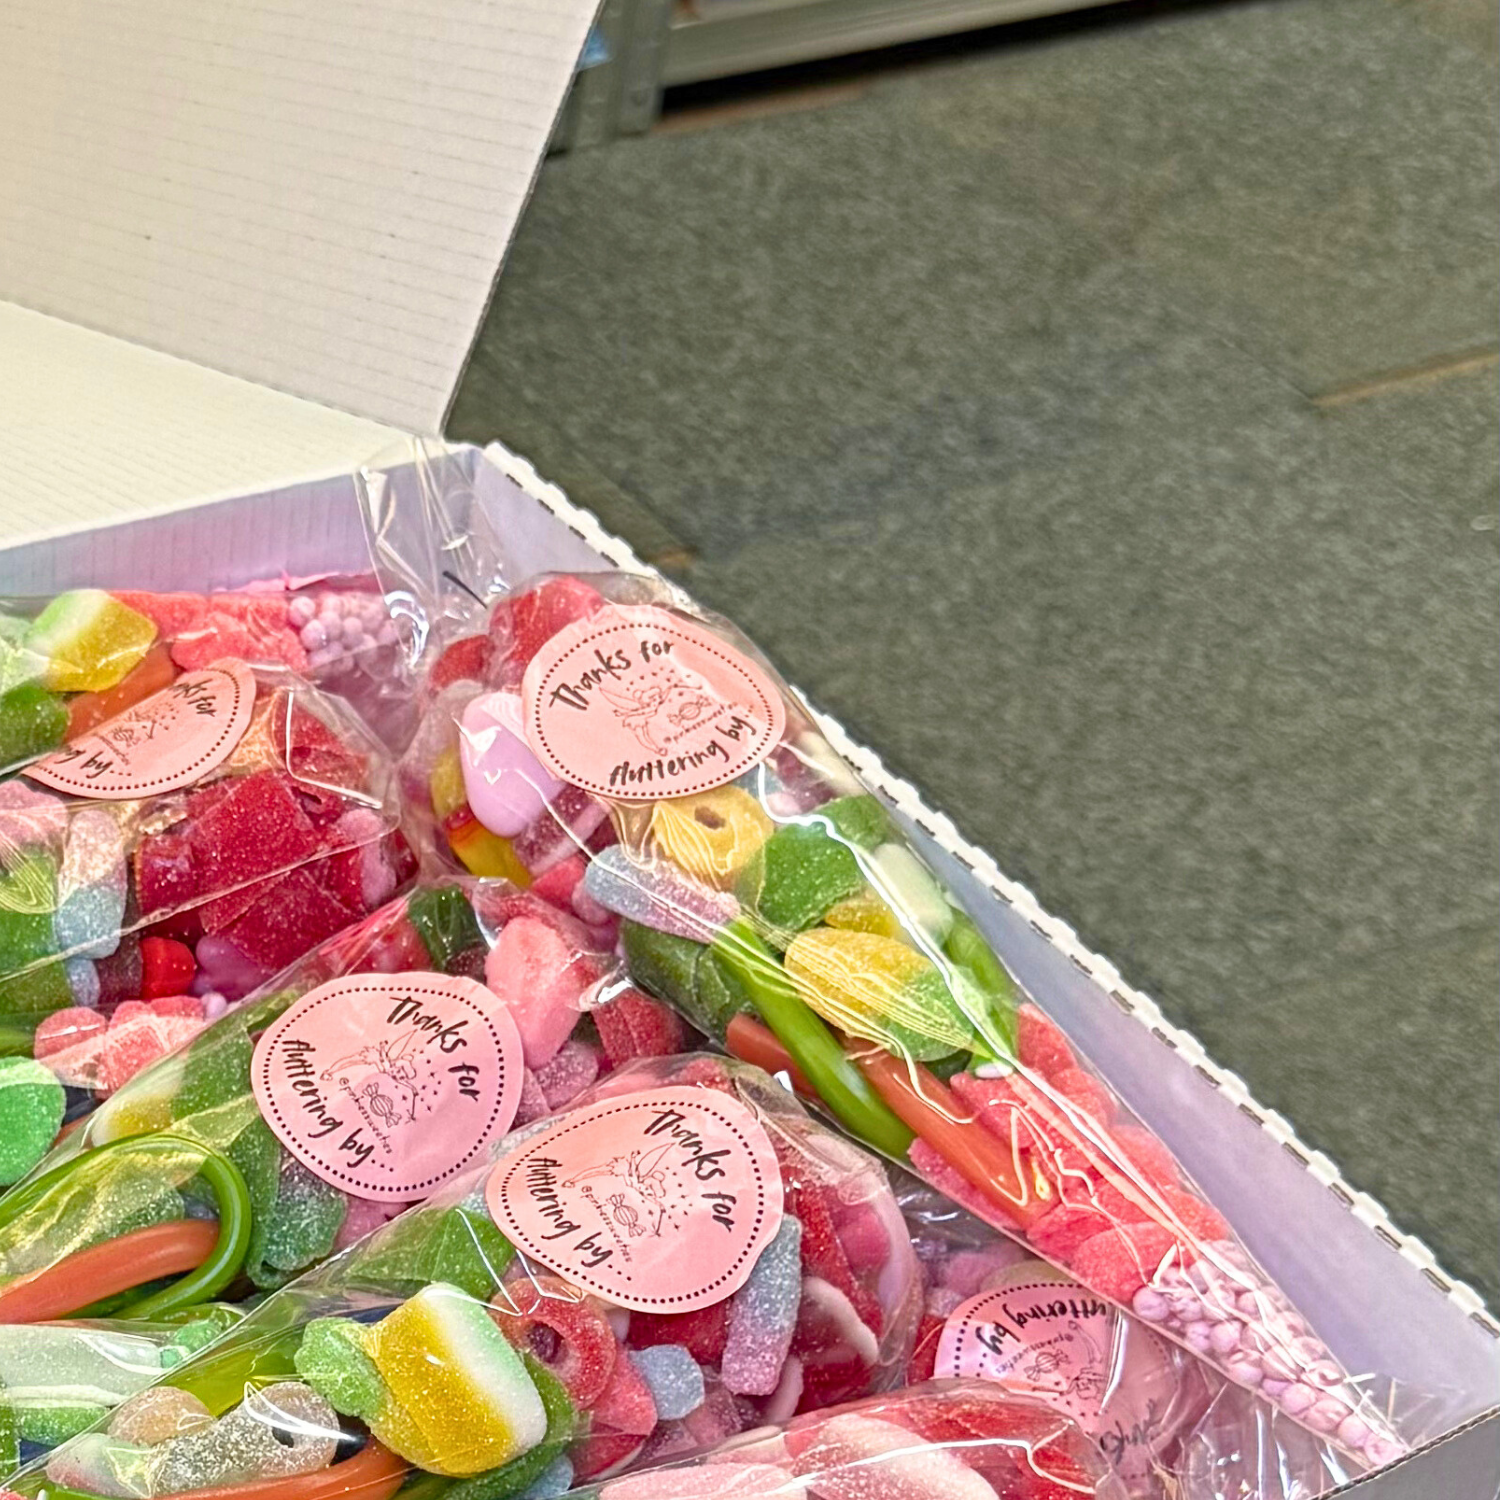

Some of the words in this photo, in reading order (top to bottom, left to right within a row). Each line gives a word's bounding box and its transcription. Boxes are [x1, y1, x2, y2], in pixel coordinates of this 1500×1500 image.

[188, 695, 216, 716] for
[550, 649, 631, 710] Thanks
[640, 640, 674, 662] for
[609, 740, 730, 787] fluttering
[387, 995, 469, 1053] Thanks
[448, 1061, 480, 1102] for
[281, 1038, 344, 1138] fluttering
[526, 1157, 581, 1240] fluttering
[644, 1109, 731, 1180] Thanks
[701, 1192, 737, 1232] for
[1002, 1298, 1107, 1328] uttering
